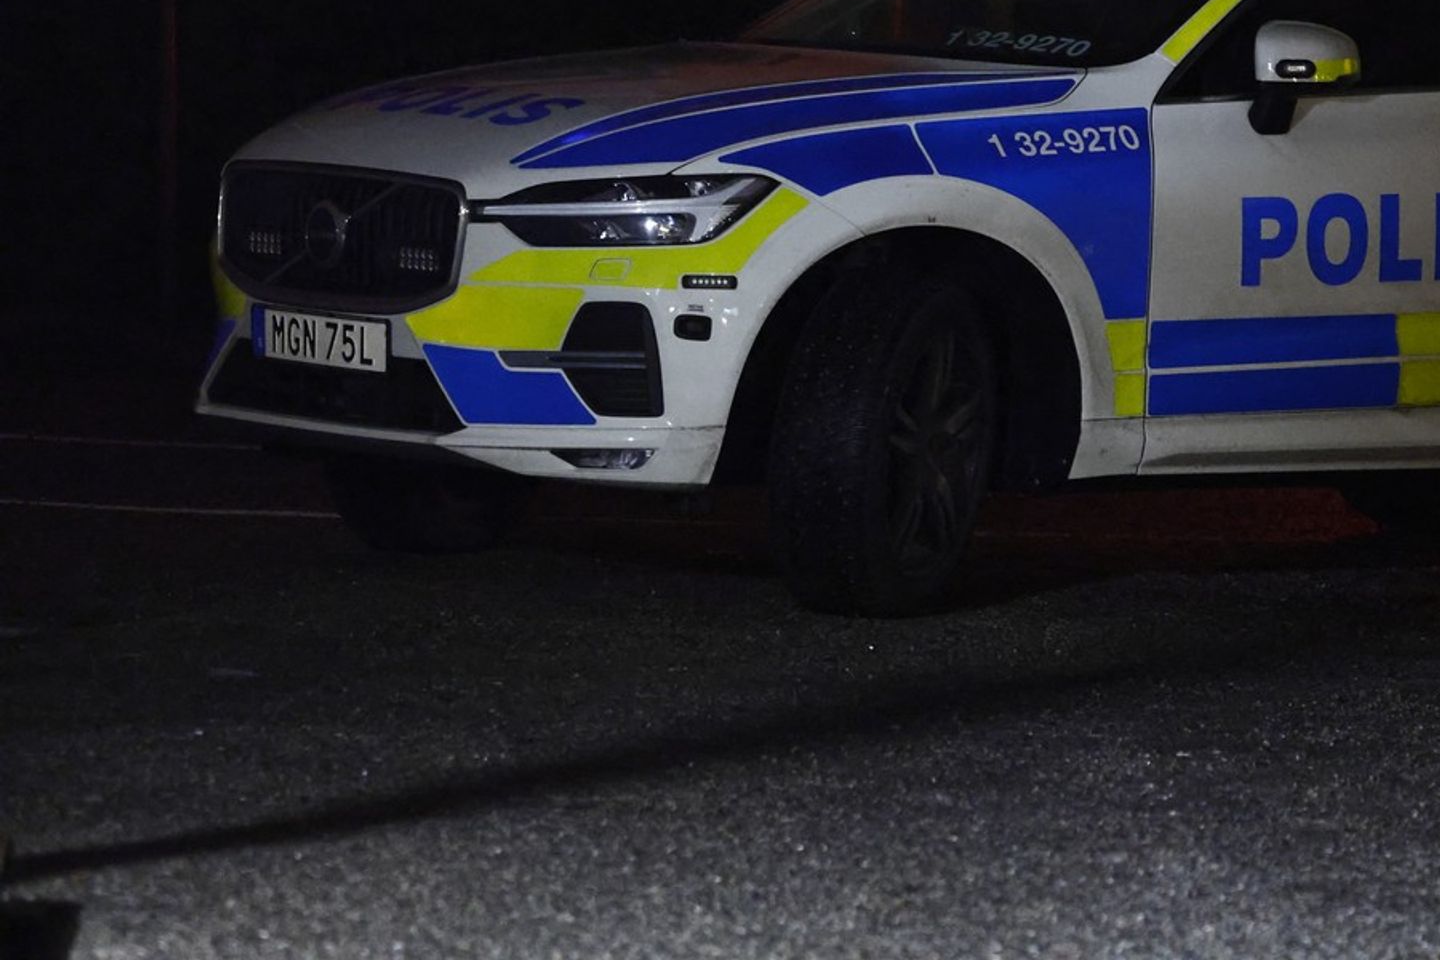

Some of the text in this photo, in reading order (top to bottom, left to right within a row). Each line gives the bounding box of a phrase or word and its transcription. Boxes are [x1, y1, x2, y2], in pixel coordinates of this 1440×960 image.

[946, 30, 1091, 57] 1 32-9270
[987, 125, 1140, 158] 1 32-9270
[272, 314, 373, 365] MGN 75L
